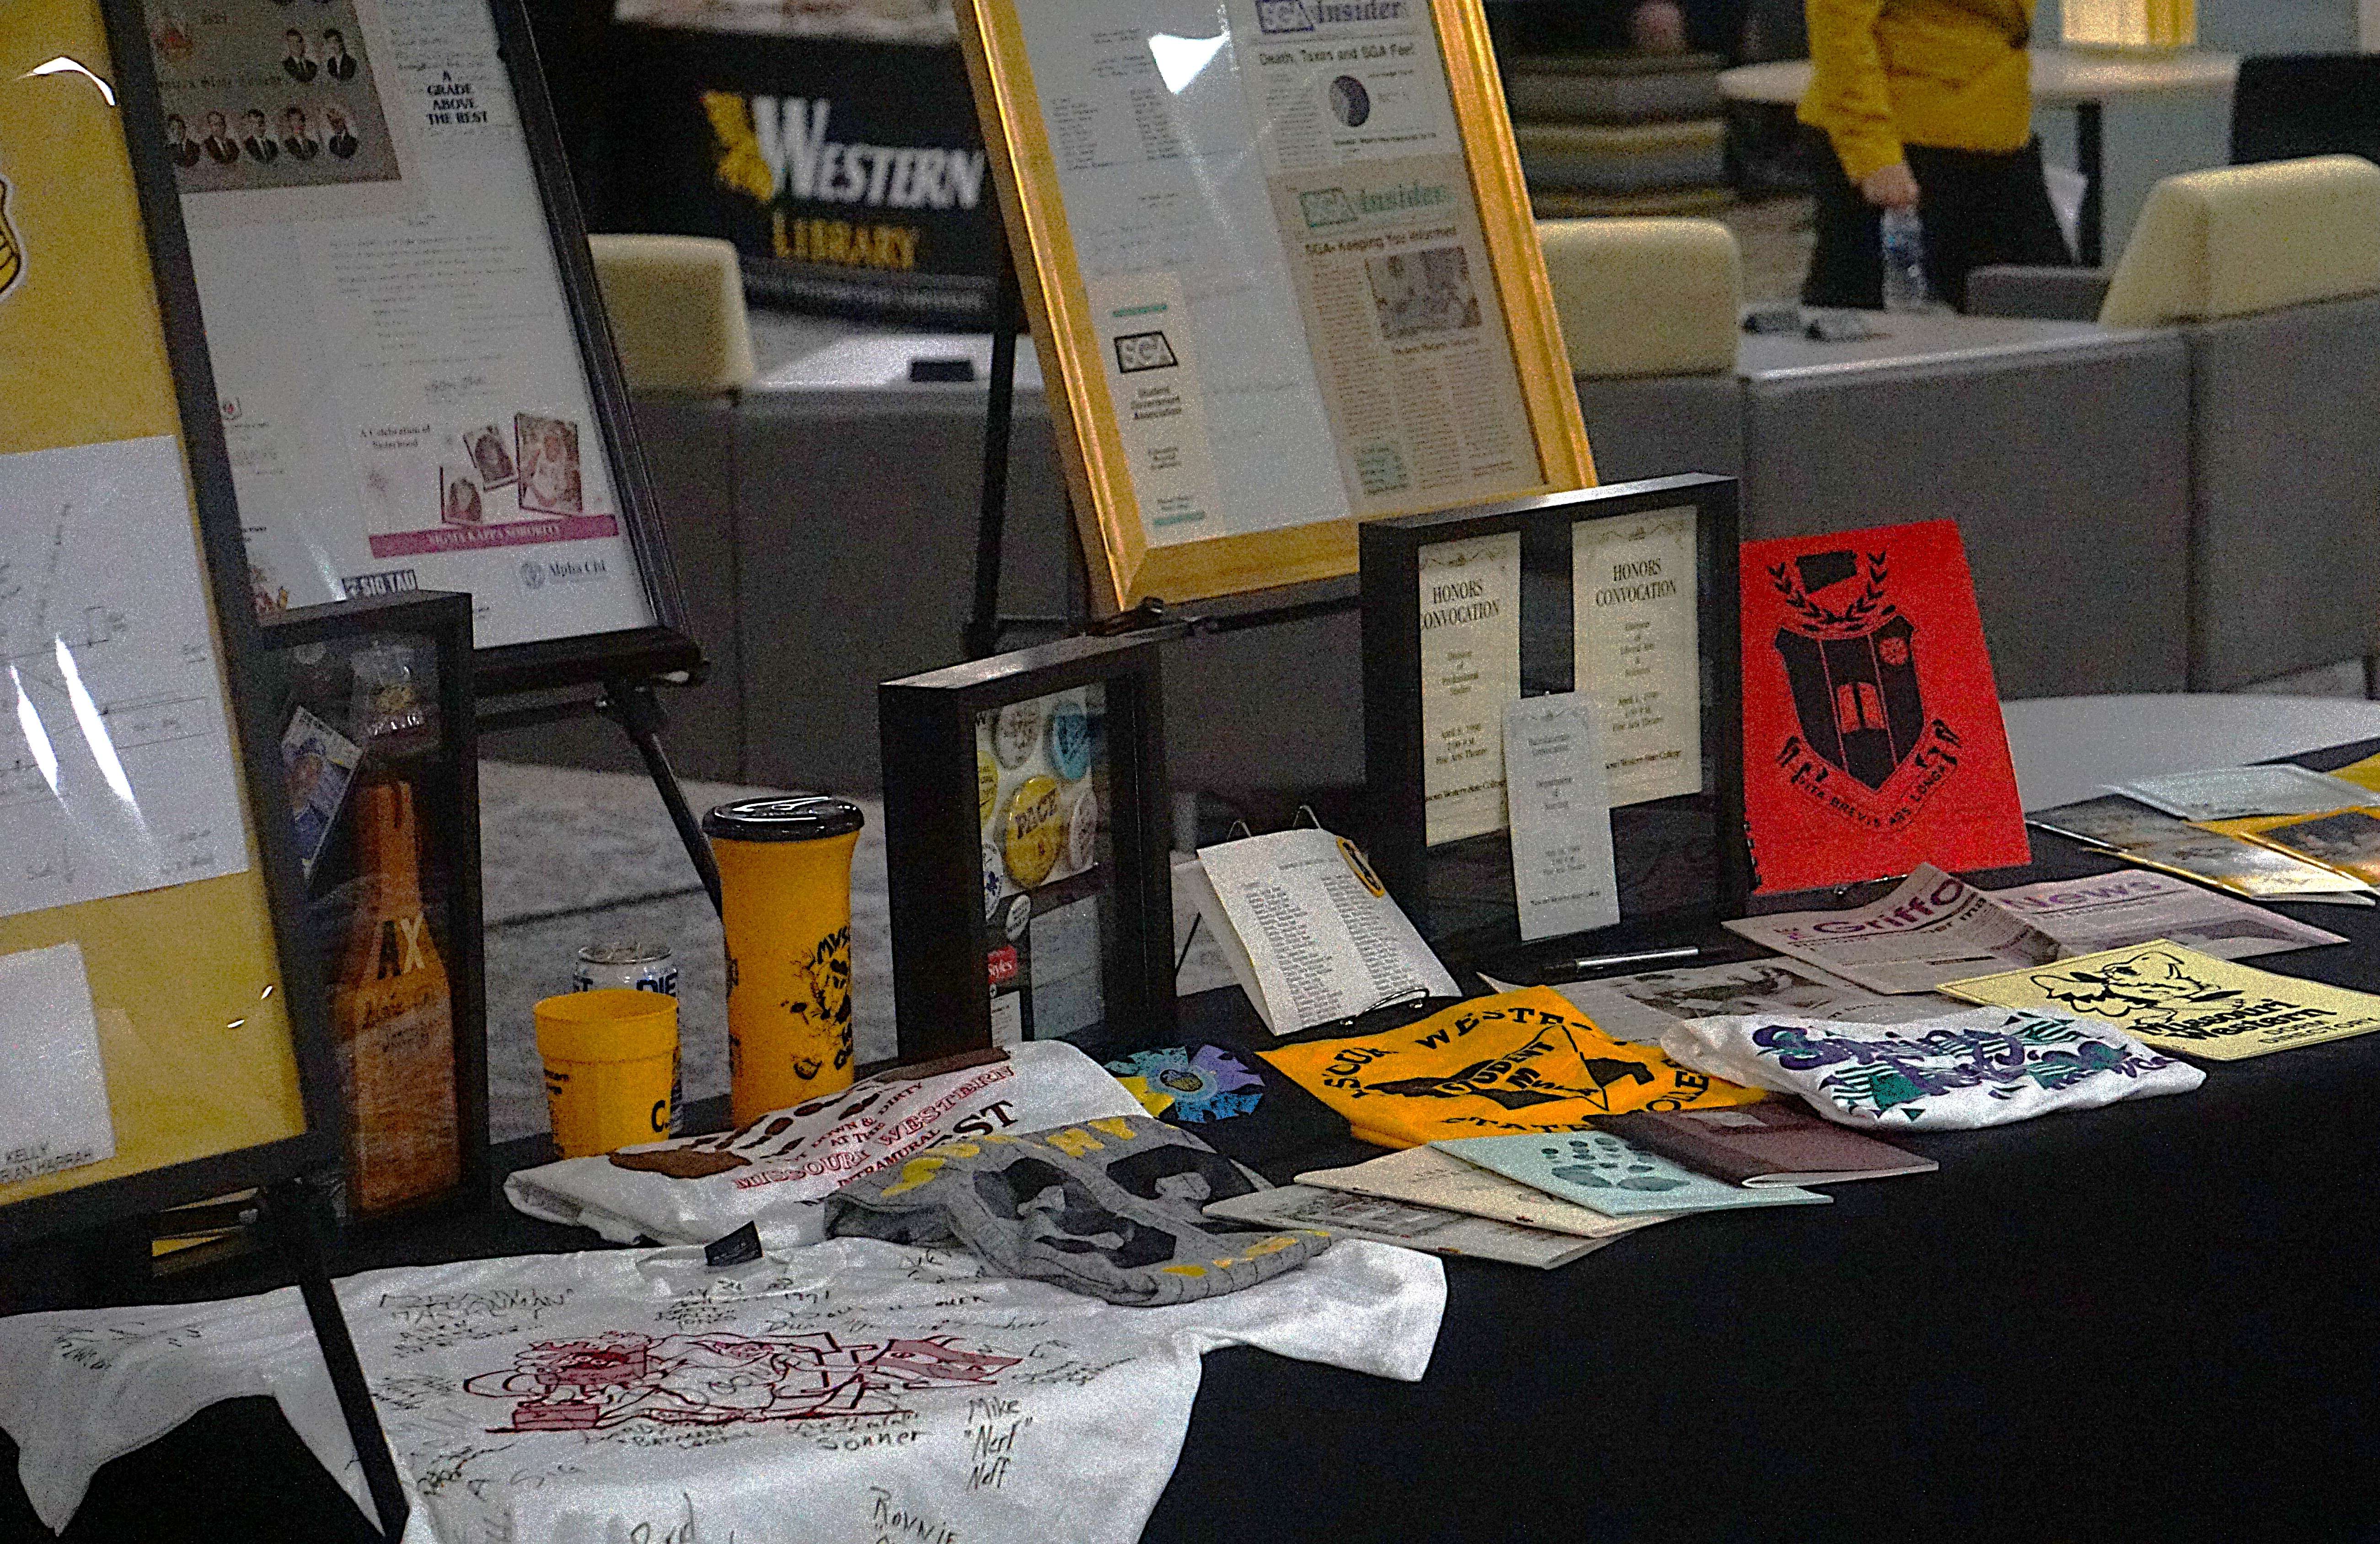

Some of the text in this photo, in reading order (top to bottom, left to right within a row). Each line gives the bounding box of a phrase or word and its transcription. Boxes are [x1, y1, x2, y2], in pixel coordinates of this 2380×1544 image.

[1337, 48, 1359, 61] and
[442, 70, 452, 81] A
[427, 83, 472, 96] GRADE
[433, 98, 477, 110] ABOVE
[426, 110, 488, 125] THE REST
[751, 94, 984, 210] WESTERN
[773, 208, 918, 269] LIBRARY
[550, 562, 582, 578] Alpha
[1613, 558, 1662, 582] HONORS
[1432, 579, 1484, 604] HONORS
[1595, 579, 1678, 607] CONVOCATION
[1813, 877, 1964, 933] Griffo
[1441, 1041, 1555, 1098] STUDENT
[878, 1081, 923, 1116] DIRTY
[732, 1064, 1016, 1190] MISSOURI WESTERN
[831, 1135, 850, 1147] AT
[969, 1396, 1019, 1424] Mike
